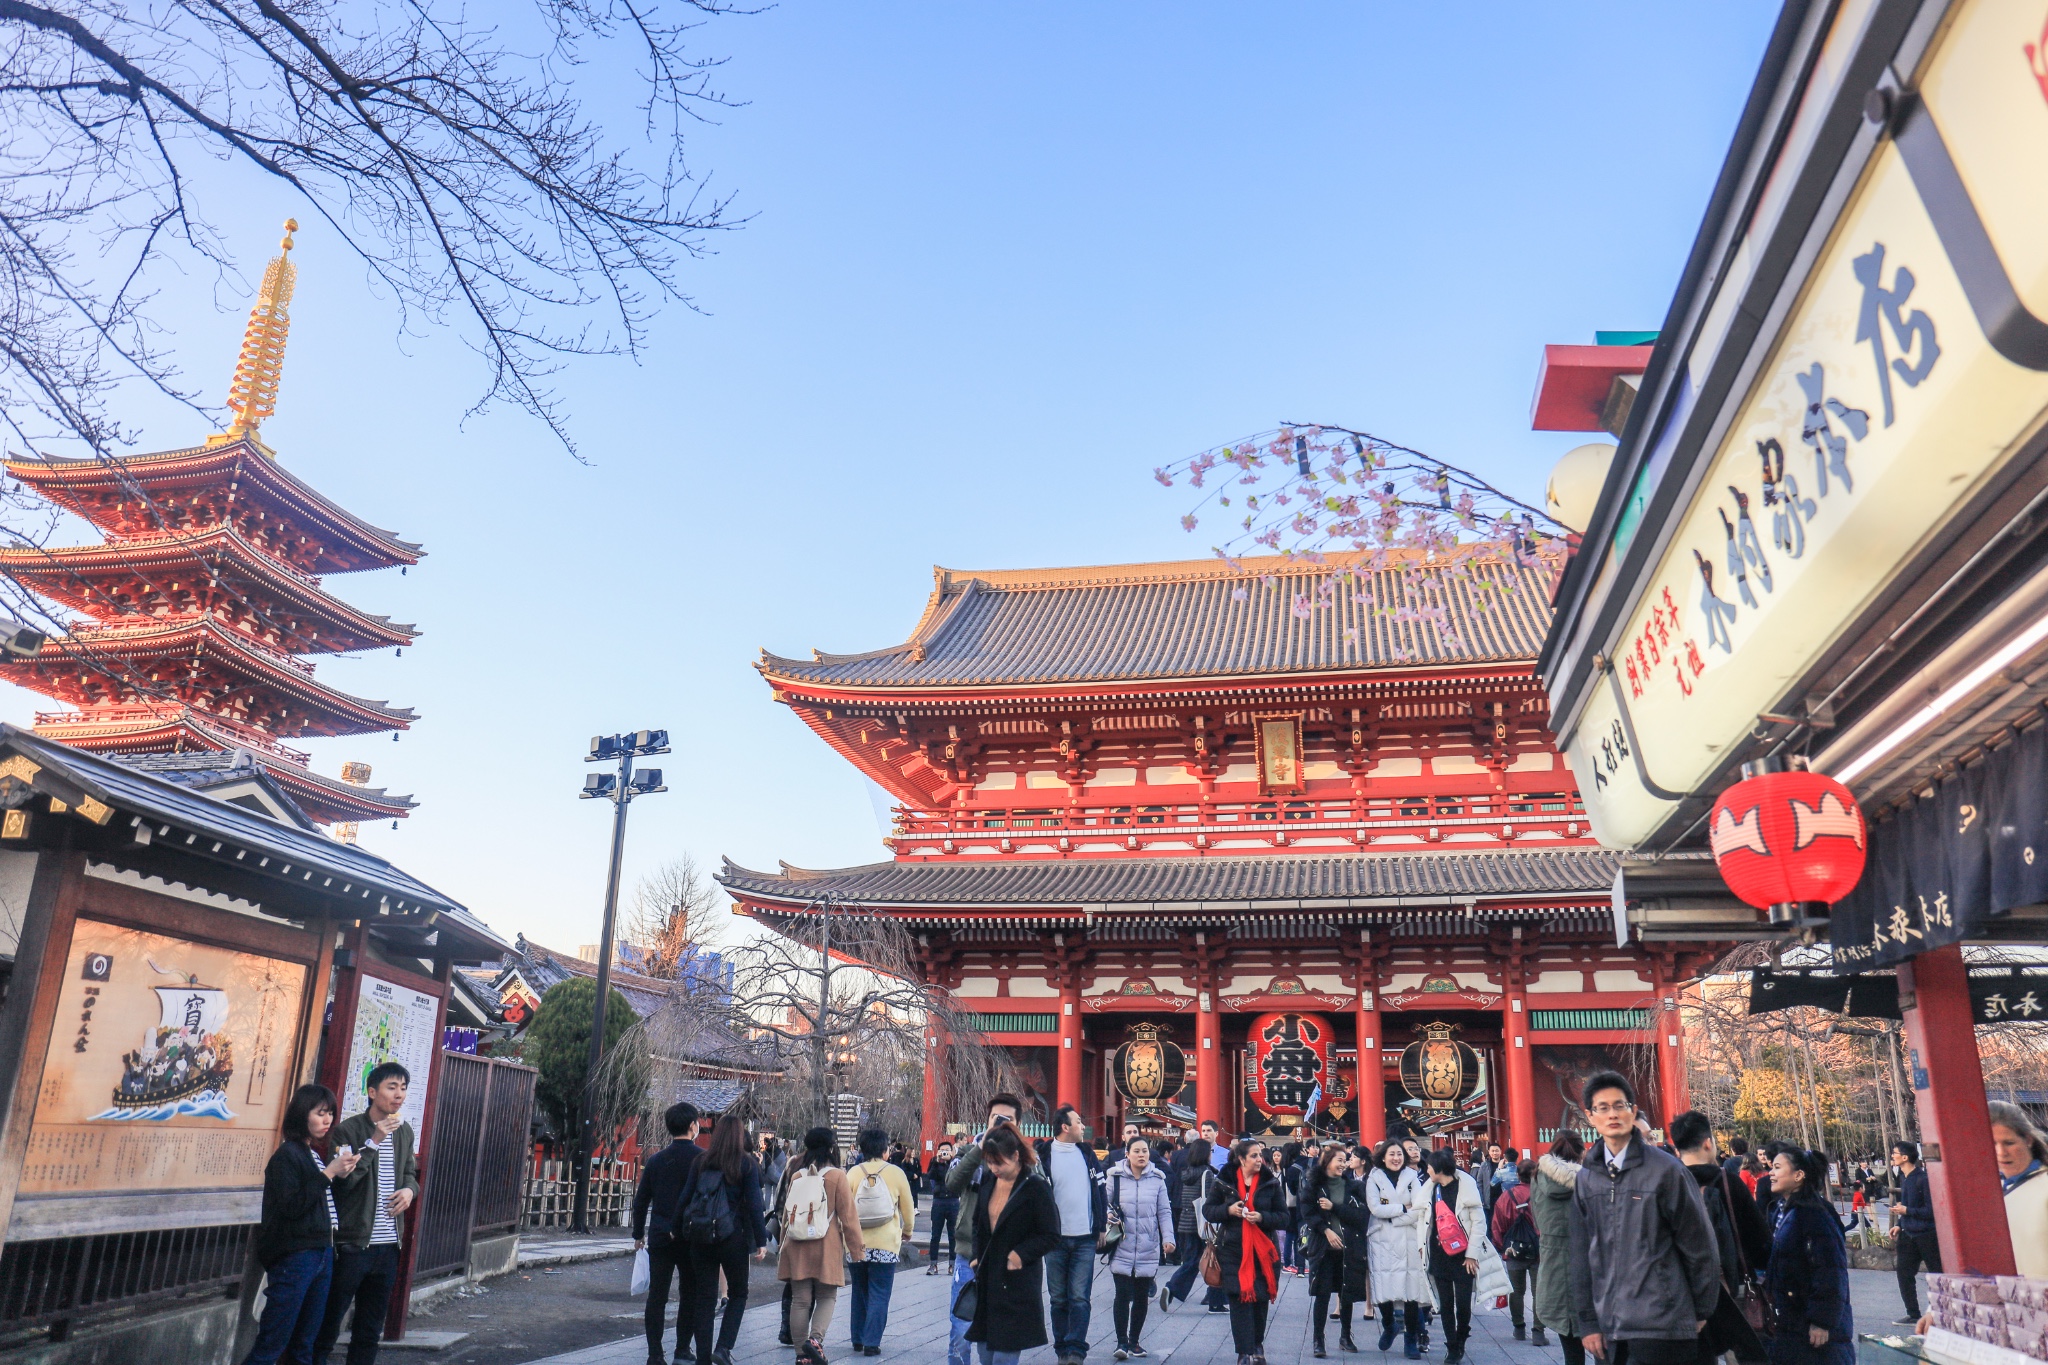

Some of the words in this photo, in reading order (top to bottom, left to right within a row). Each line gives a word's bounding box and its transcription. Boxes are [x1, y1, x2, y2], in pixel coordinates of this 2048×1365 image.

[1625, 586, 1681, 700] 創業百余年
[1673, 639, 1705, 700] 元祖
[1261, 1013, 1322, 1111] 小舟町
